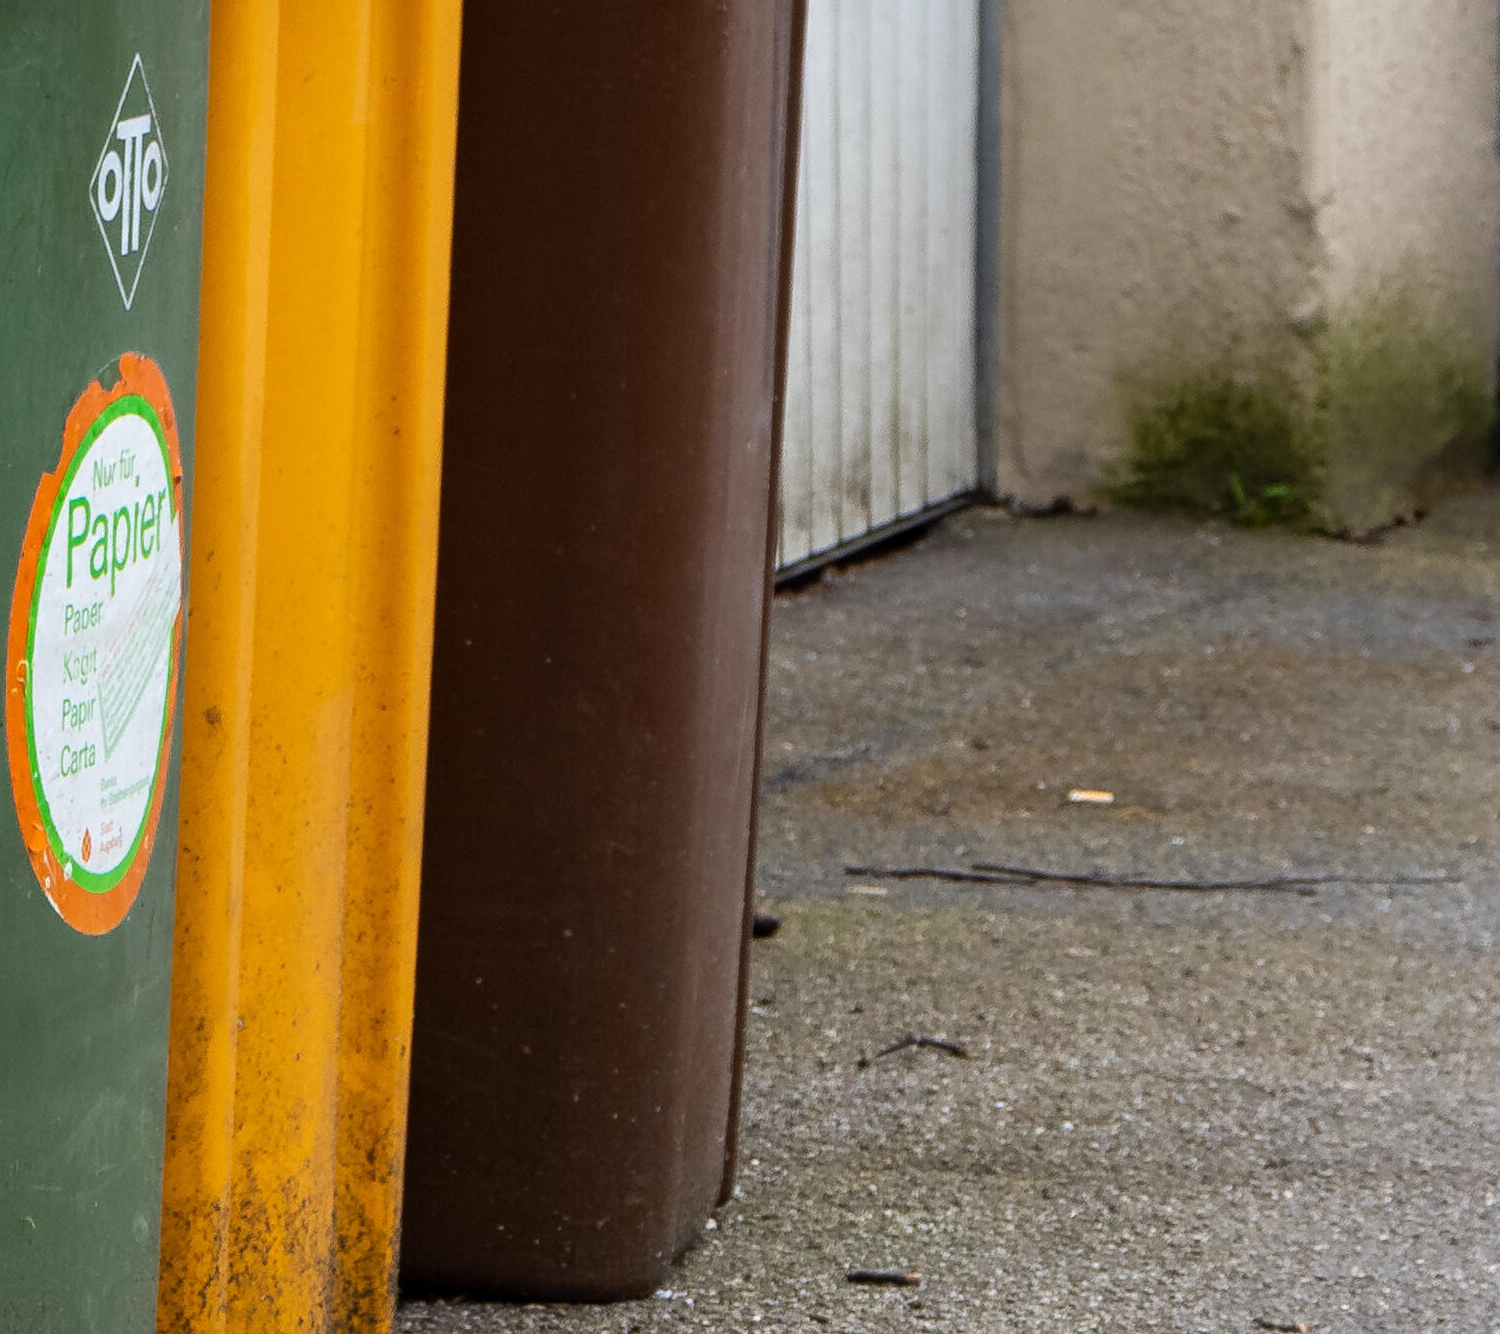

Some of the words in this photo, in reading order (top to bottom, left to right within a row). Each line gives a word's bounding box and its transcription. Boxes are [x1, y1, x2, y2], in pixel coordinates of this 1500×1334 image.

[92, 456, 117, 492] Nur
[119, 447, 137, 483] für
[66, 474, 167, 598] Papier
[64, 601, 104, 637] Paper
[61, 692, 97, 733] Papir
[60, 741, 96, 777] Carta
